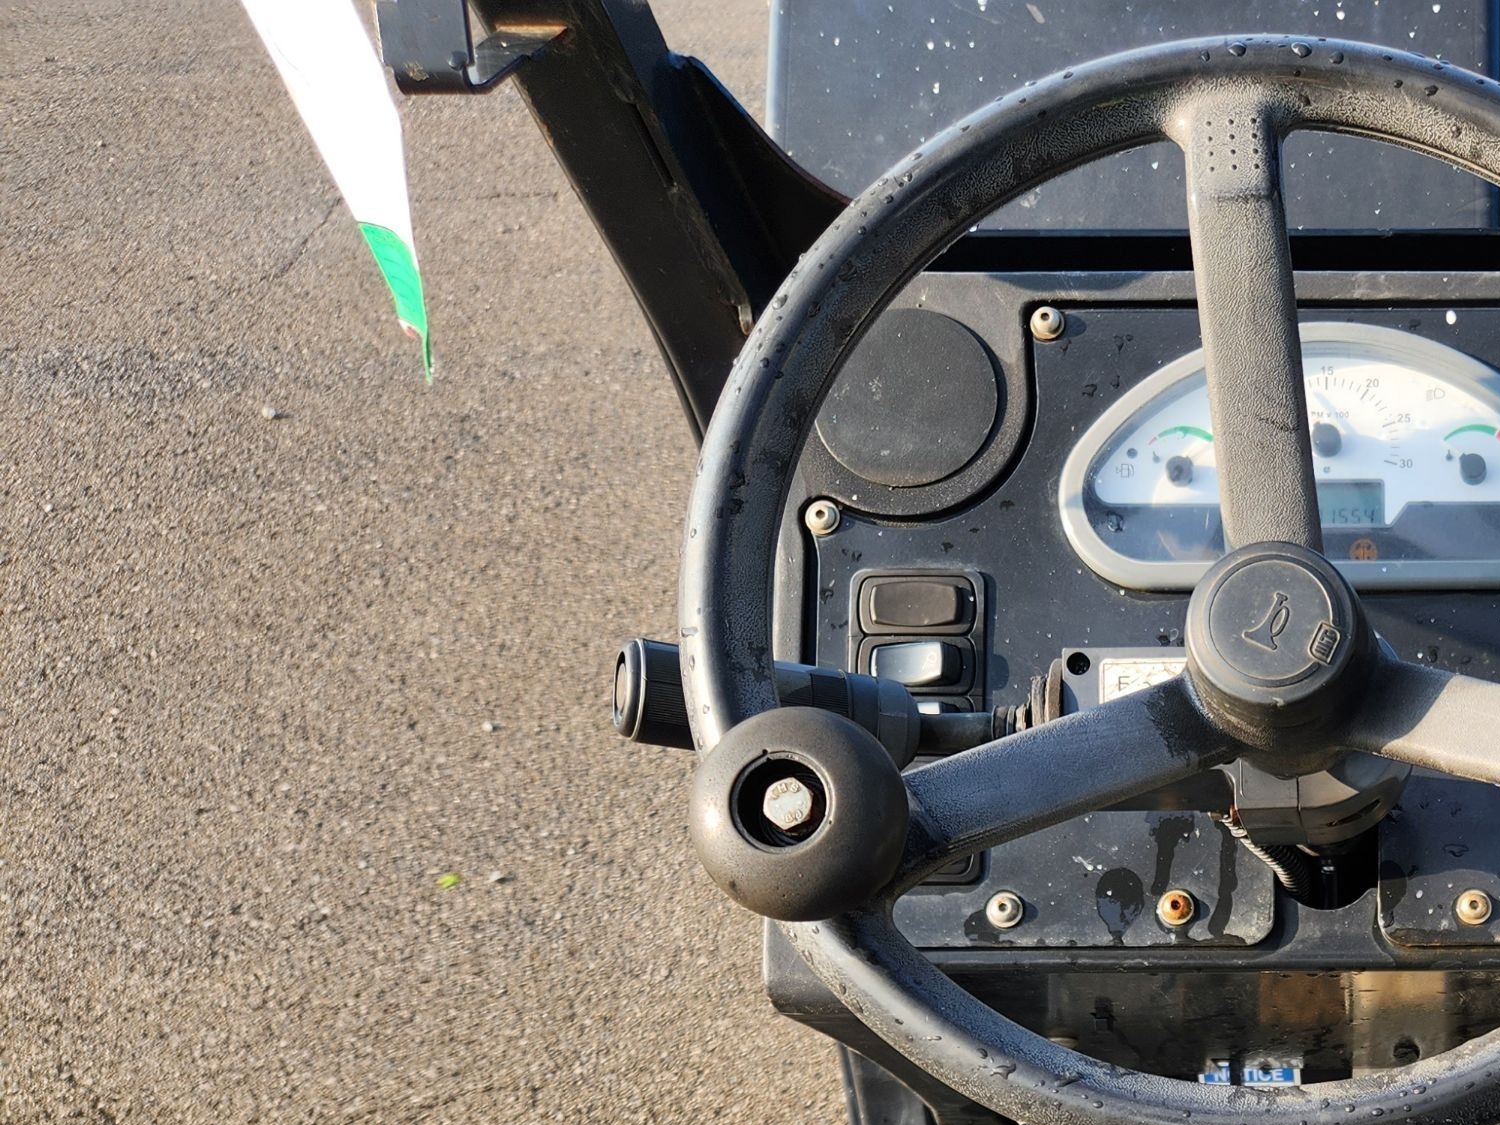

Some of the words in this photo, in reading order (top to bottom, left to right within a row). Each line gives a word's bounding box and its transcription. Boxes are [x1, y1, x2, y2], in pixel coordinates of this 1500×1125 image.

[1322, 366, 1334, 375] 15
[1366, 379, 1379, 388] 20
[1398, 414, 1411, 423] 25
[1400, 459, 1413, 468] 30
[1214, 1067, 1284, 1082] NTICE
